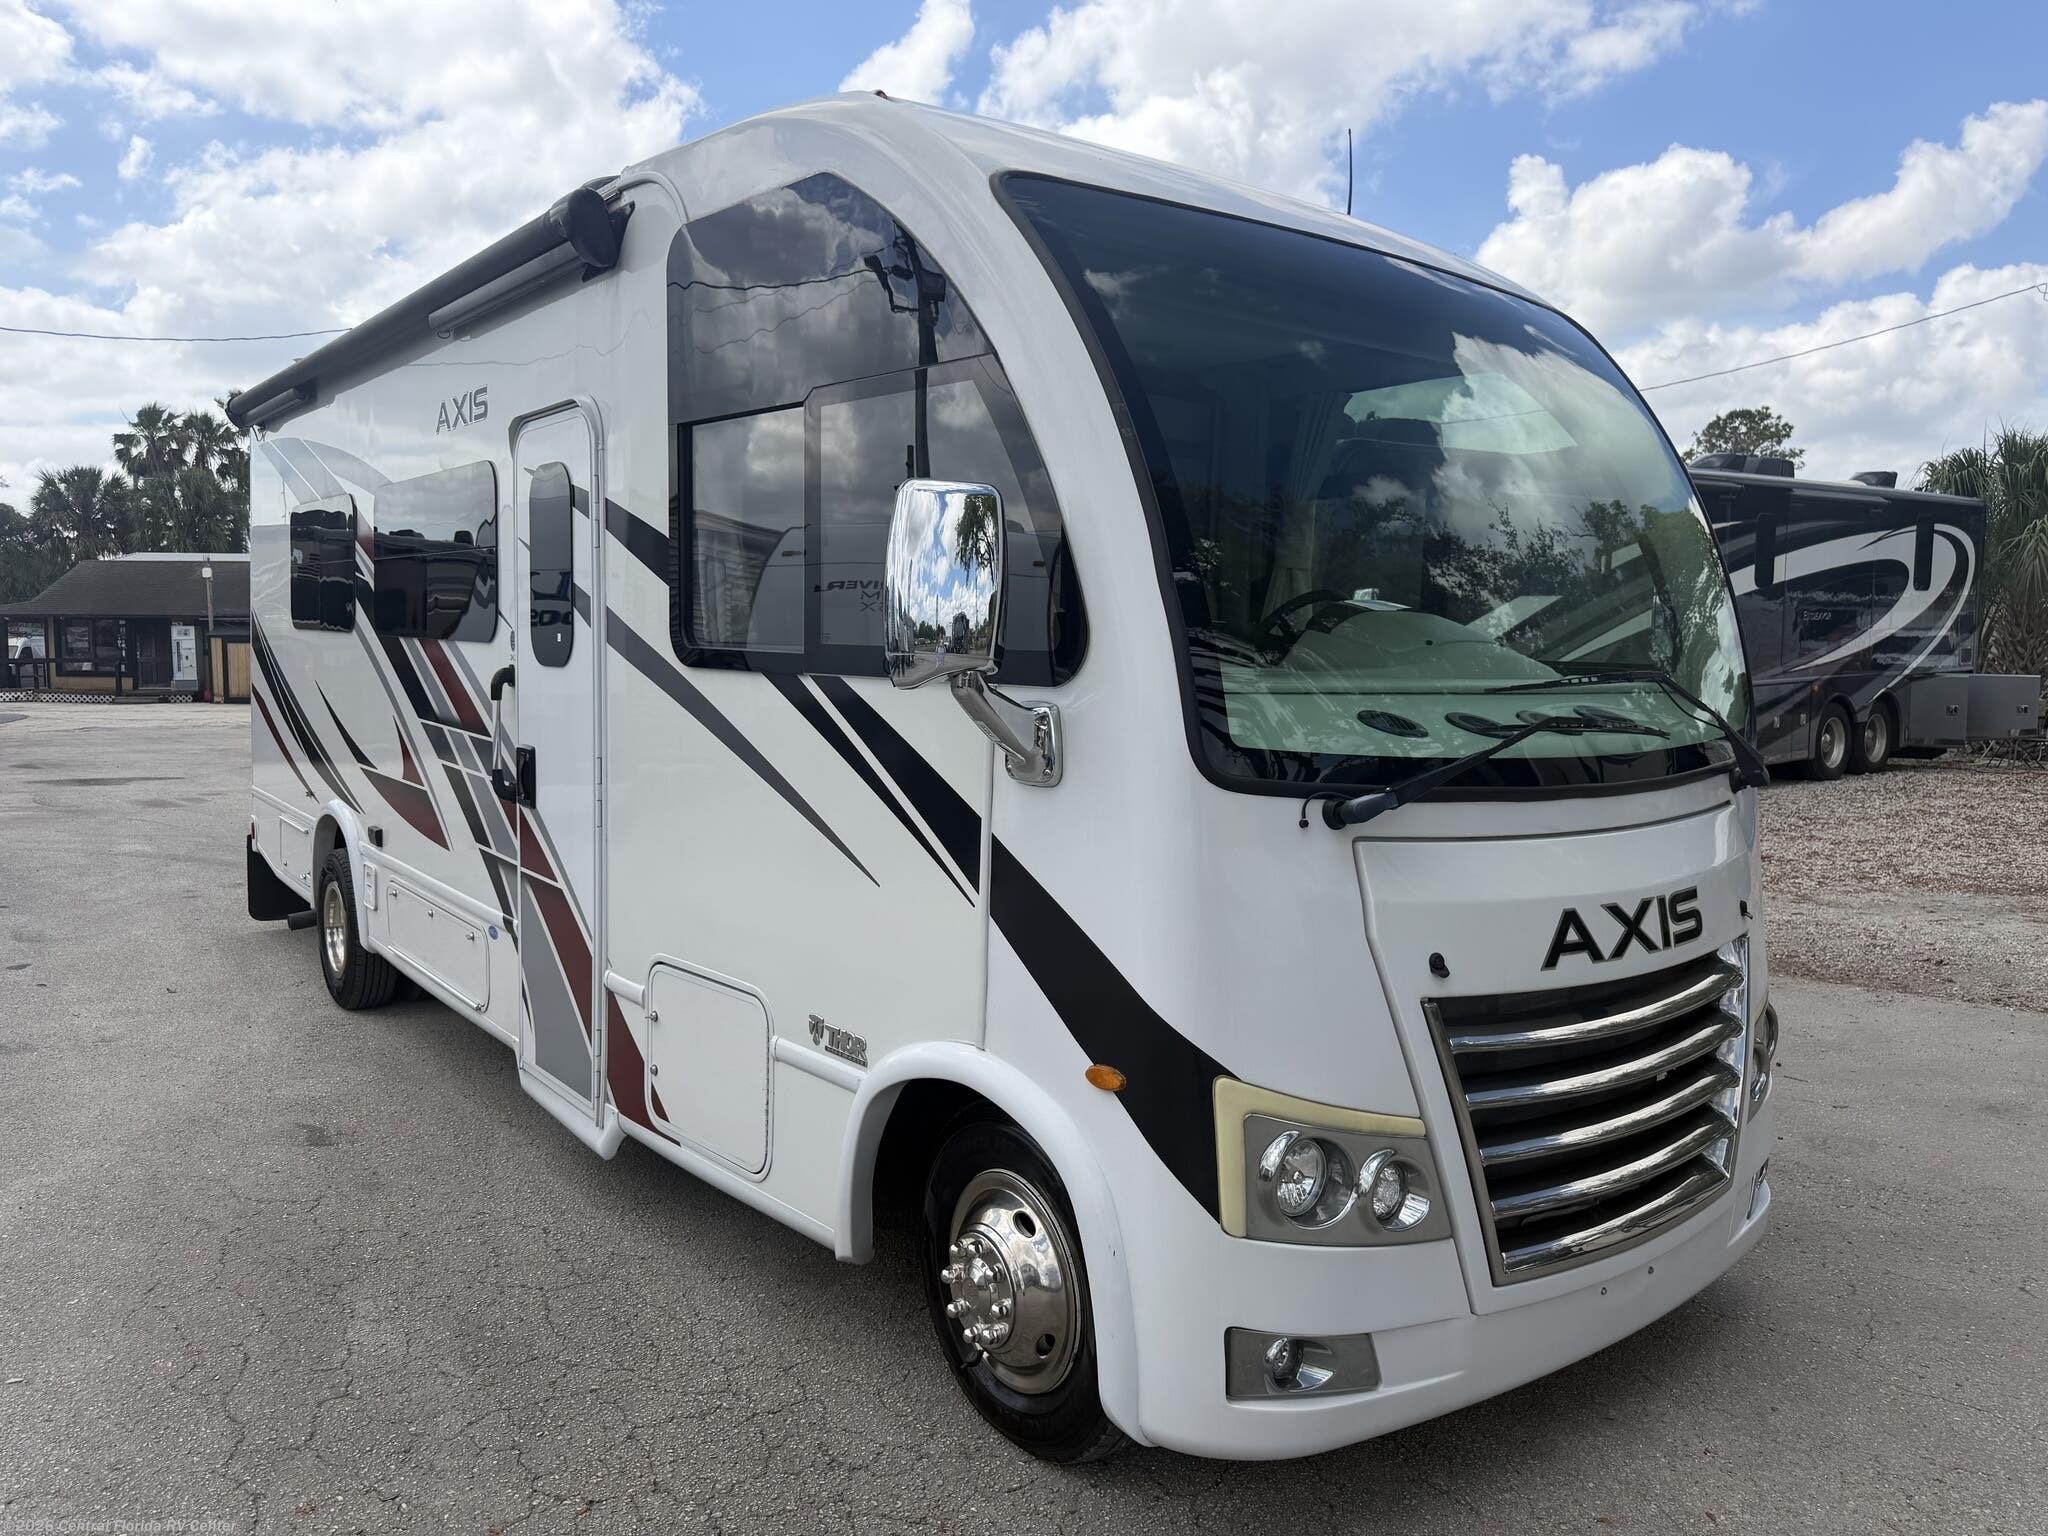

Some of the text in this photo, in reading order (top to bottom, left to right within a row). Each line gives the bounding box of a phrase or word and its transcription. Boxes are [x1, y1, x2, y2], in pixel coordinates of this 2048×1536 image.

[436, 386, 488, 434] AXIS
[1541, 885, 1703, 971] AXIS
[825, 1023, 868, 1061] THOR
